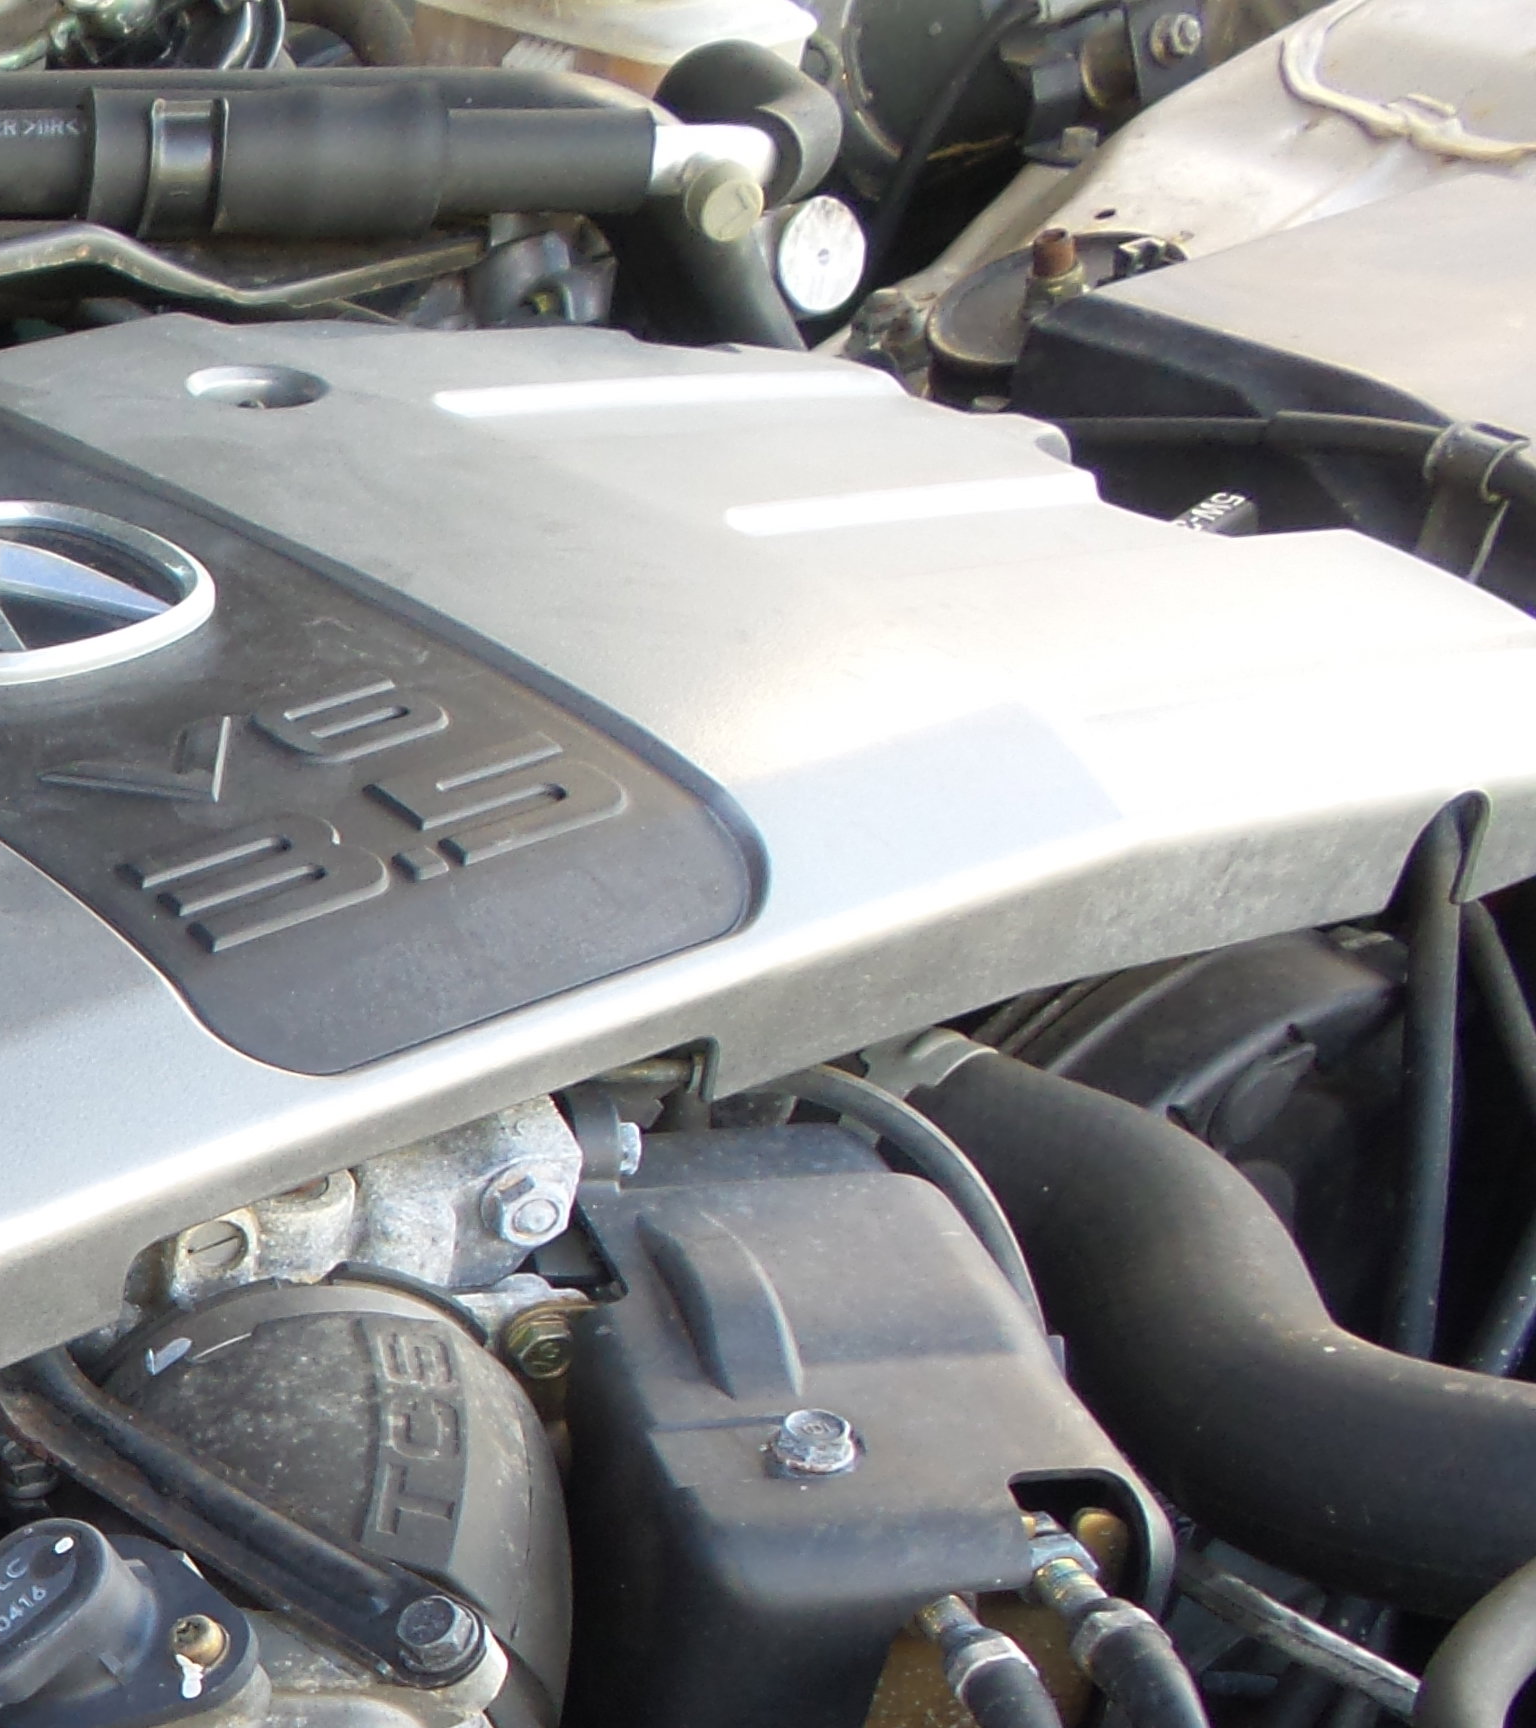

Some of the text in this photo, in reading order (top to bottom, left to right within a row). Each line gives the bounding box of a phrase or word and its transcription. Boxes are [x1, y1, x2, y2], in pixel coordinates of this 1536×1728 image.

[39, 675, 452, 802] V6
[117, 735, 630, 954] 3.5
[372, 1328, 462, 1553] TCS
